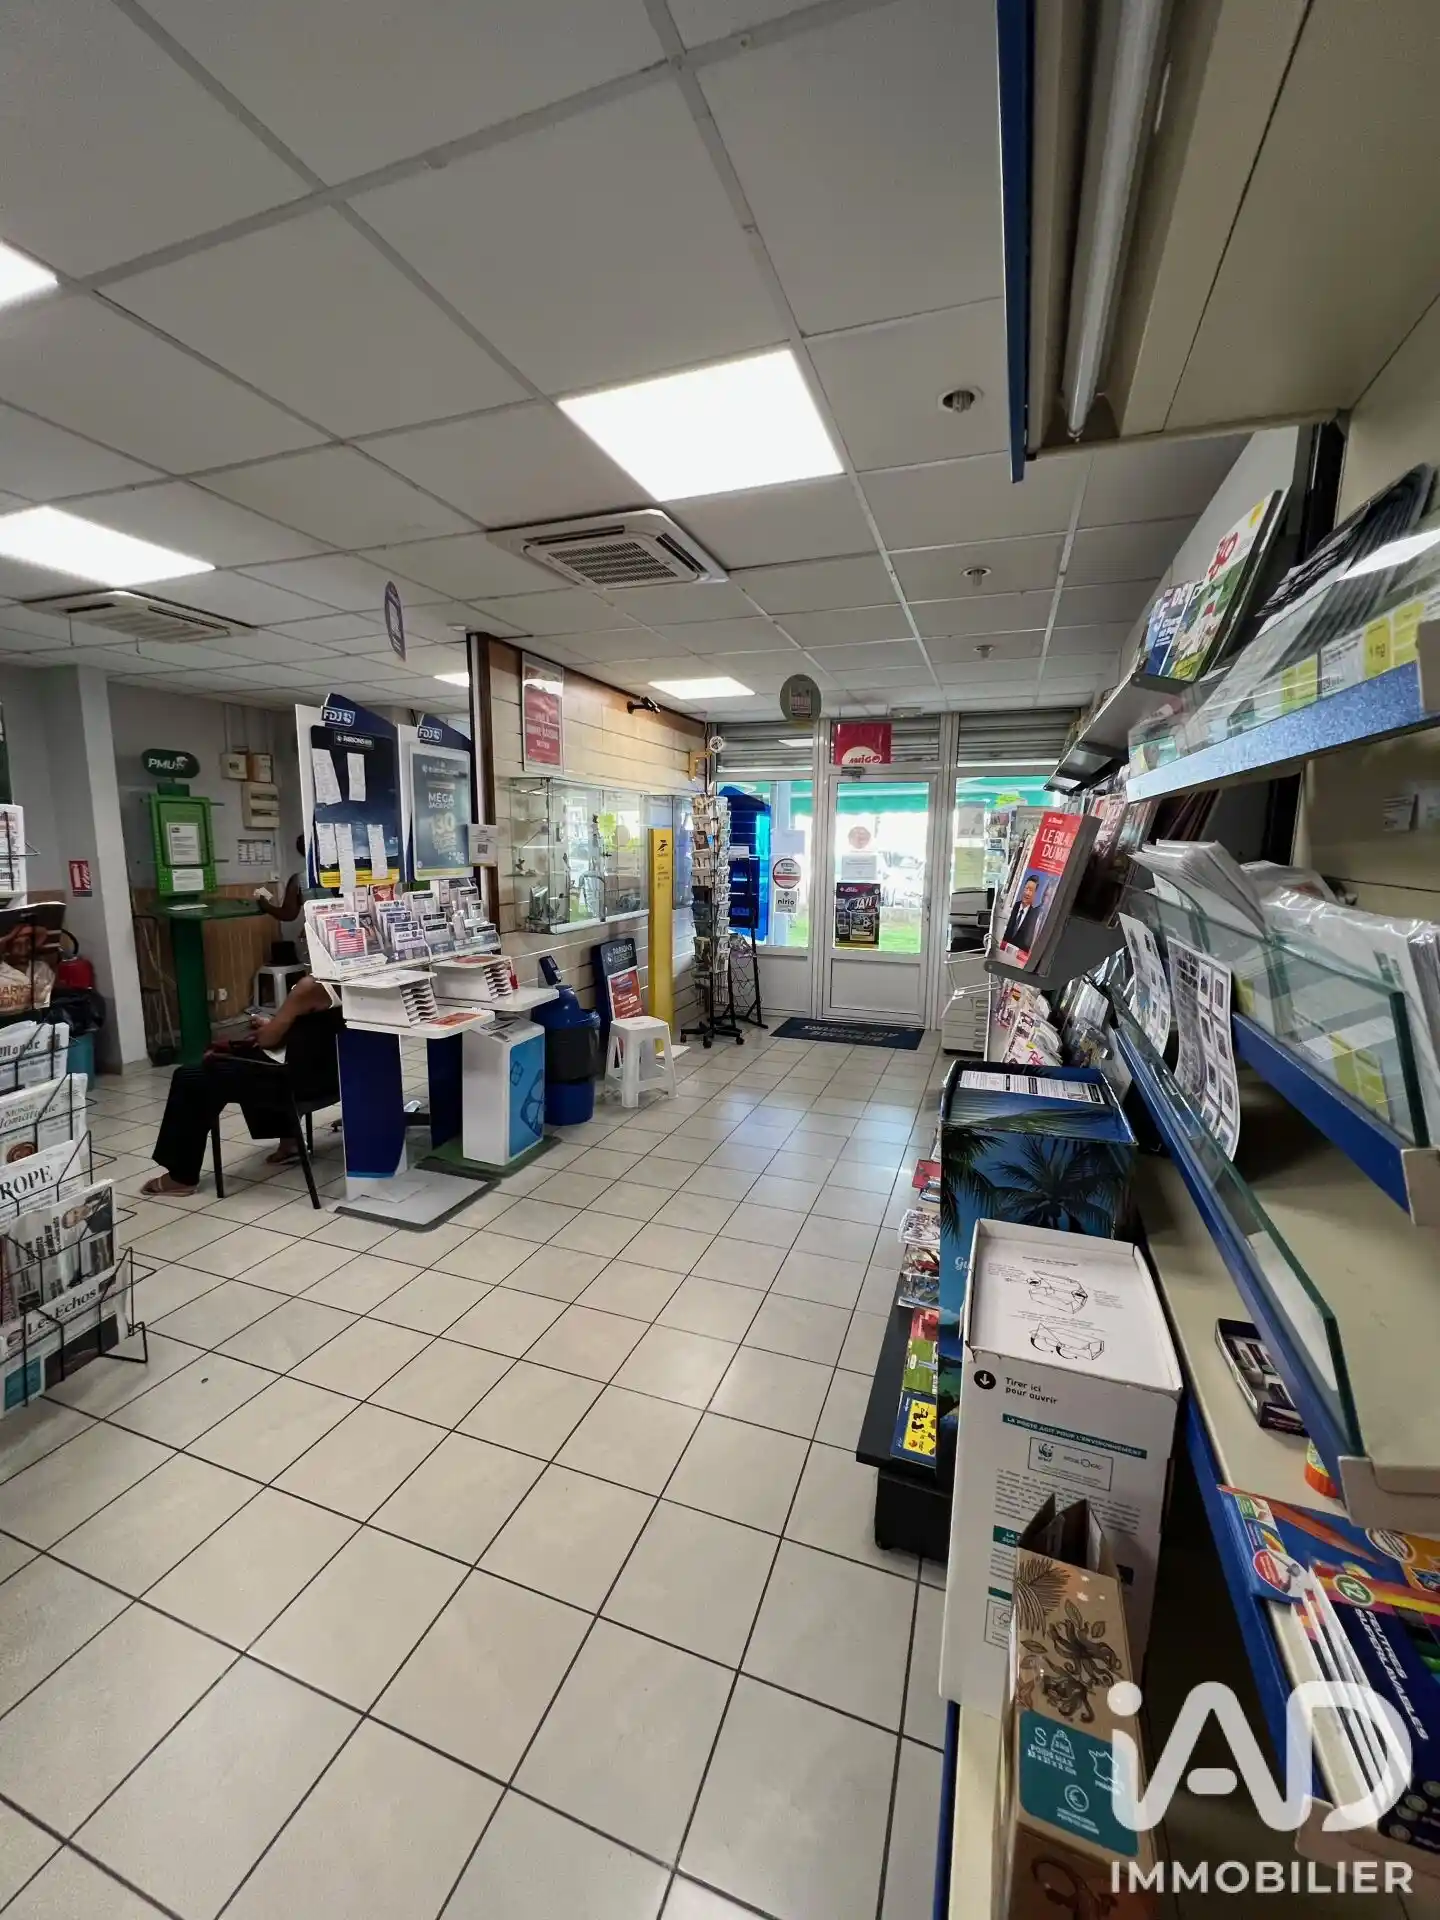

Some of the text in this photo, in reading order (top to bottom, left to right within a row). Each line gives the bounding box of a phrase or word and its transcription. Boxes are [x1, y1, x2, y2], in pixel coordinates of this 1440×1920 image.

[323, 709, 341, 722] FDJ
[418, 730, 432, 742] FDJ
[148, 758, 175, 770] PMU
[428, 791, 454, 804] MÉGA
[1041, 828, 1056, 843] LE
[1042, 844, 1057, 859] DU
[55, 1288, 97, 1320] Echos
[1005, 1377, 1042, 1393] Tirer ici
[1005, 1387, 1059, 1404] pour ouvrir
[1016, 1418, 1038, 1430] POSTE
[1056, 1429, 1076, 1440] POUR
[1365, 1609, 1408, 1680] FEUTRES
[1354, 1607, 1430, 1741] SUPERLAVABLES
[1034, 1726, 1047, 1747] S
